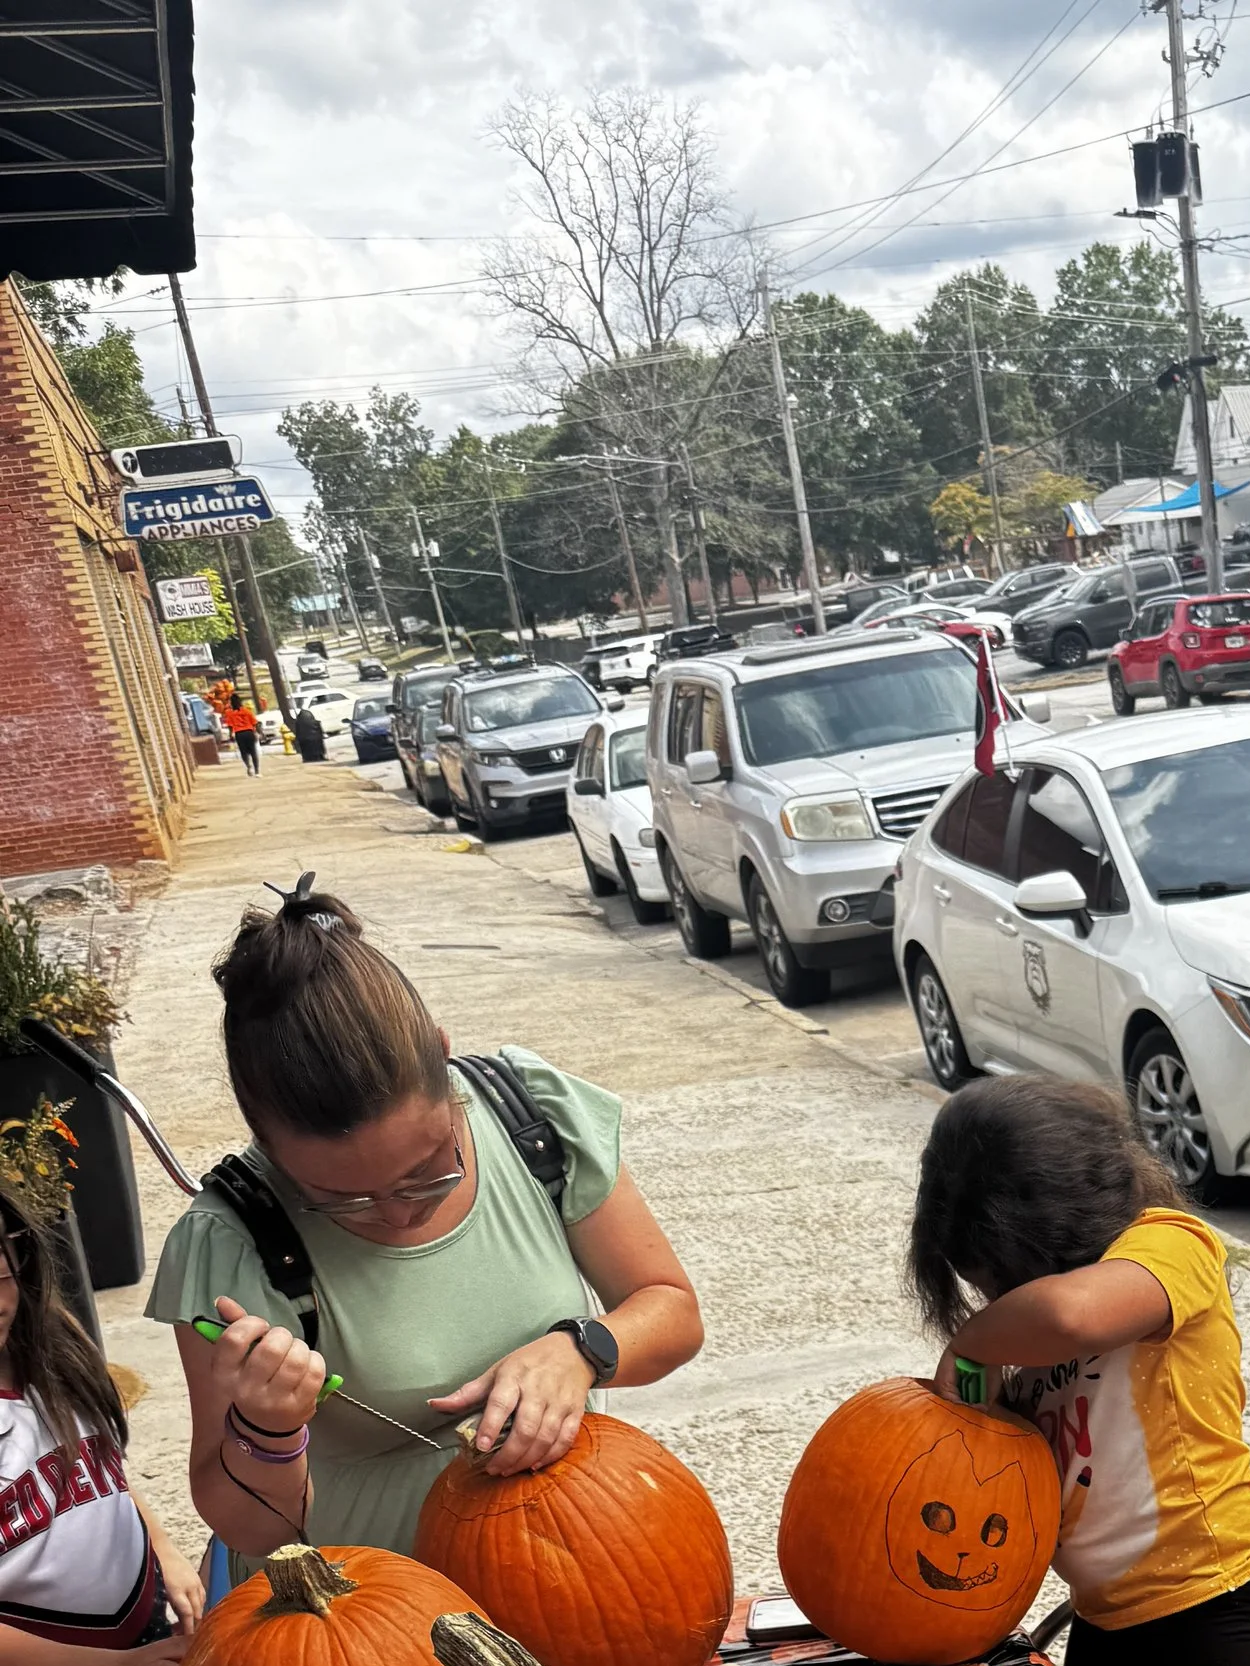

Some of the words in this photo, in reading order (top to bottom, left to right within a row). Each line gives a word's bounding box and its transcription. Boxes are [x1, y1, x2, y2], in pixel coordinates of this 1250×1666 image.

[127, 494, 262, 520] Frigidaire
[147, 515, 258, 540] APPLIANCES
[189, 602, 215, 615] HOUSE
